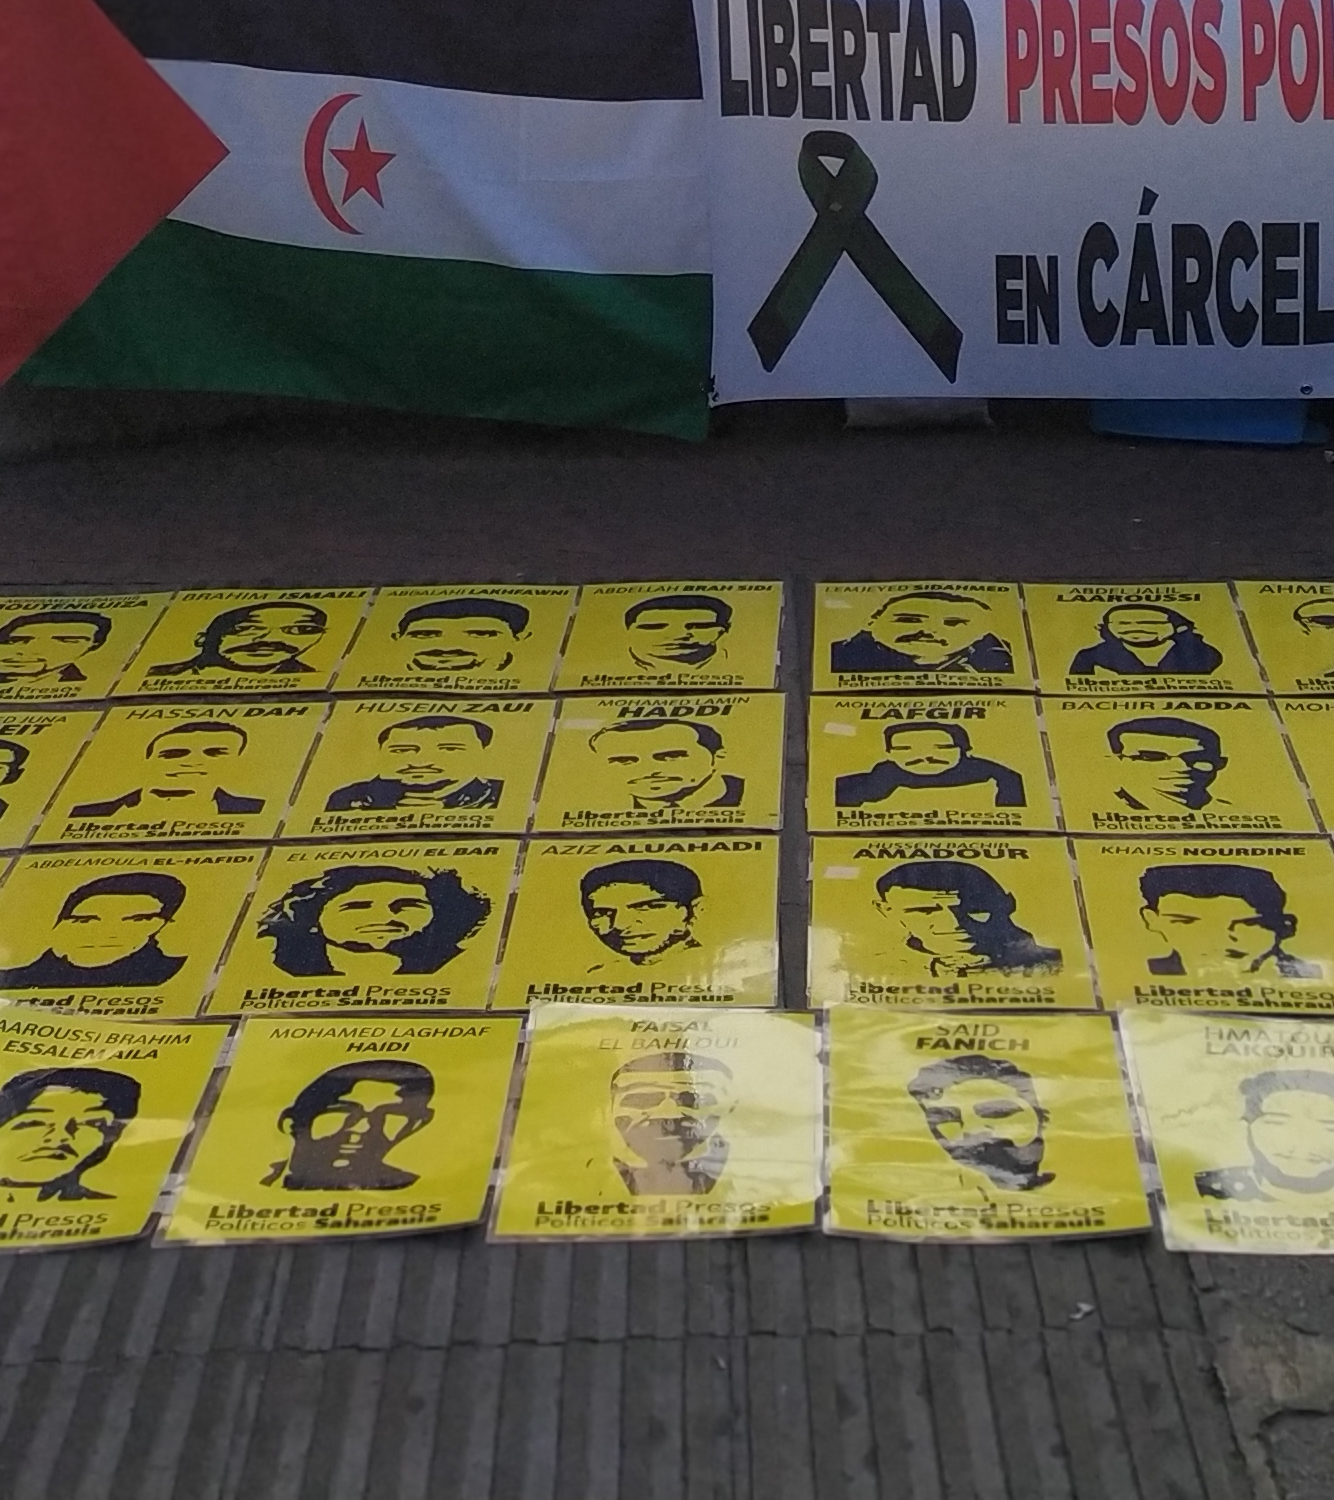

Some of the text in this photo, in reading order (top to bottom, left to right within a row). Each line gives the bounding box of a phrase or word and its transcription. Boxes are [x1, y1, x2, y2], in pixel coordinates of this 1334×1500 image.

[995, 254, 1059, 346] EN
[182, 590, 368, 601] BRAHIM ISMAILI
[1056, 592, 1202, 603] LAAROUSSI
[355, 702, 534, 713] HUSEIN ZAUI
[597, 696, 751, 707] MOHAMED LAMIN
[835, 700, 933, 709] MOHAMED
[1062, 700, 1252, 711] BACHIR JADDA
[17, 713, 68, 724] JUNA
[126, 707, 308, 719] HASSAN DAH
[617, 705, 734, 719] HADDI
[861, 707, 987, 720] LAFGIR
[287, 853, 309, 862] EL
[423, 847, 447, 857] EL
[449, 846, 500, 856] BAR
[541, 841, 764, 856] AZIZ ALUAHADI
[853, 848, 1030, 860] AMADOUR
[1101, 846, 1307, 856] KHAISS NOURDINE
[28, 855, 255, 870] ABDELMOULA EL-HAFIDI
[244, 985, 452, 1001] Libertad Presos
[337, 996, 448, 1006] Saharauis
[269, 1026, 492, 1040] MOHAMED LAGHDAF
[936, 1024, 1001, 1038] SAID
[104, 1032, 192, 1046] BRAHIM
[916, 1037, 1031, 1051] FANICH
[2, 1040, 159, 1060] ESSALEM AILA
[346, 1041, 411, 1053] HAIDI
[208, 1202, 442, 1220] Libertad Presos
[13, 1213, 109, 1227] Presos
[313, 1214, 438, 1229] Saharauis
